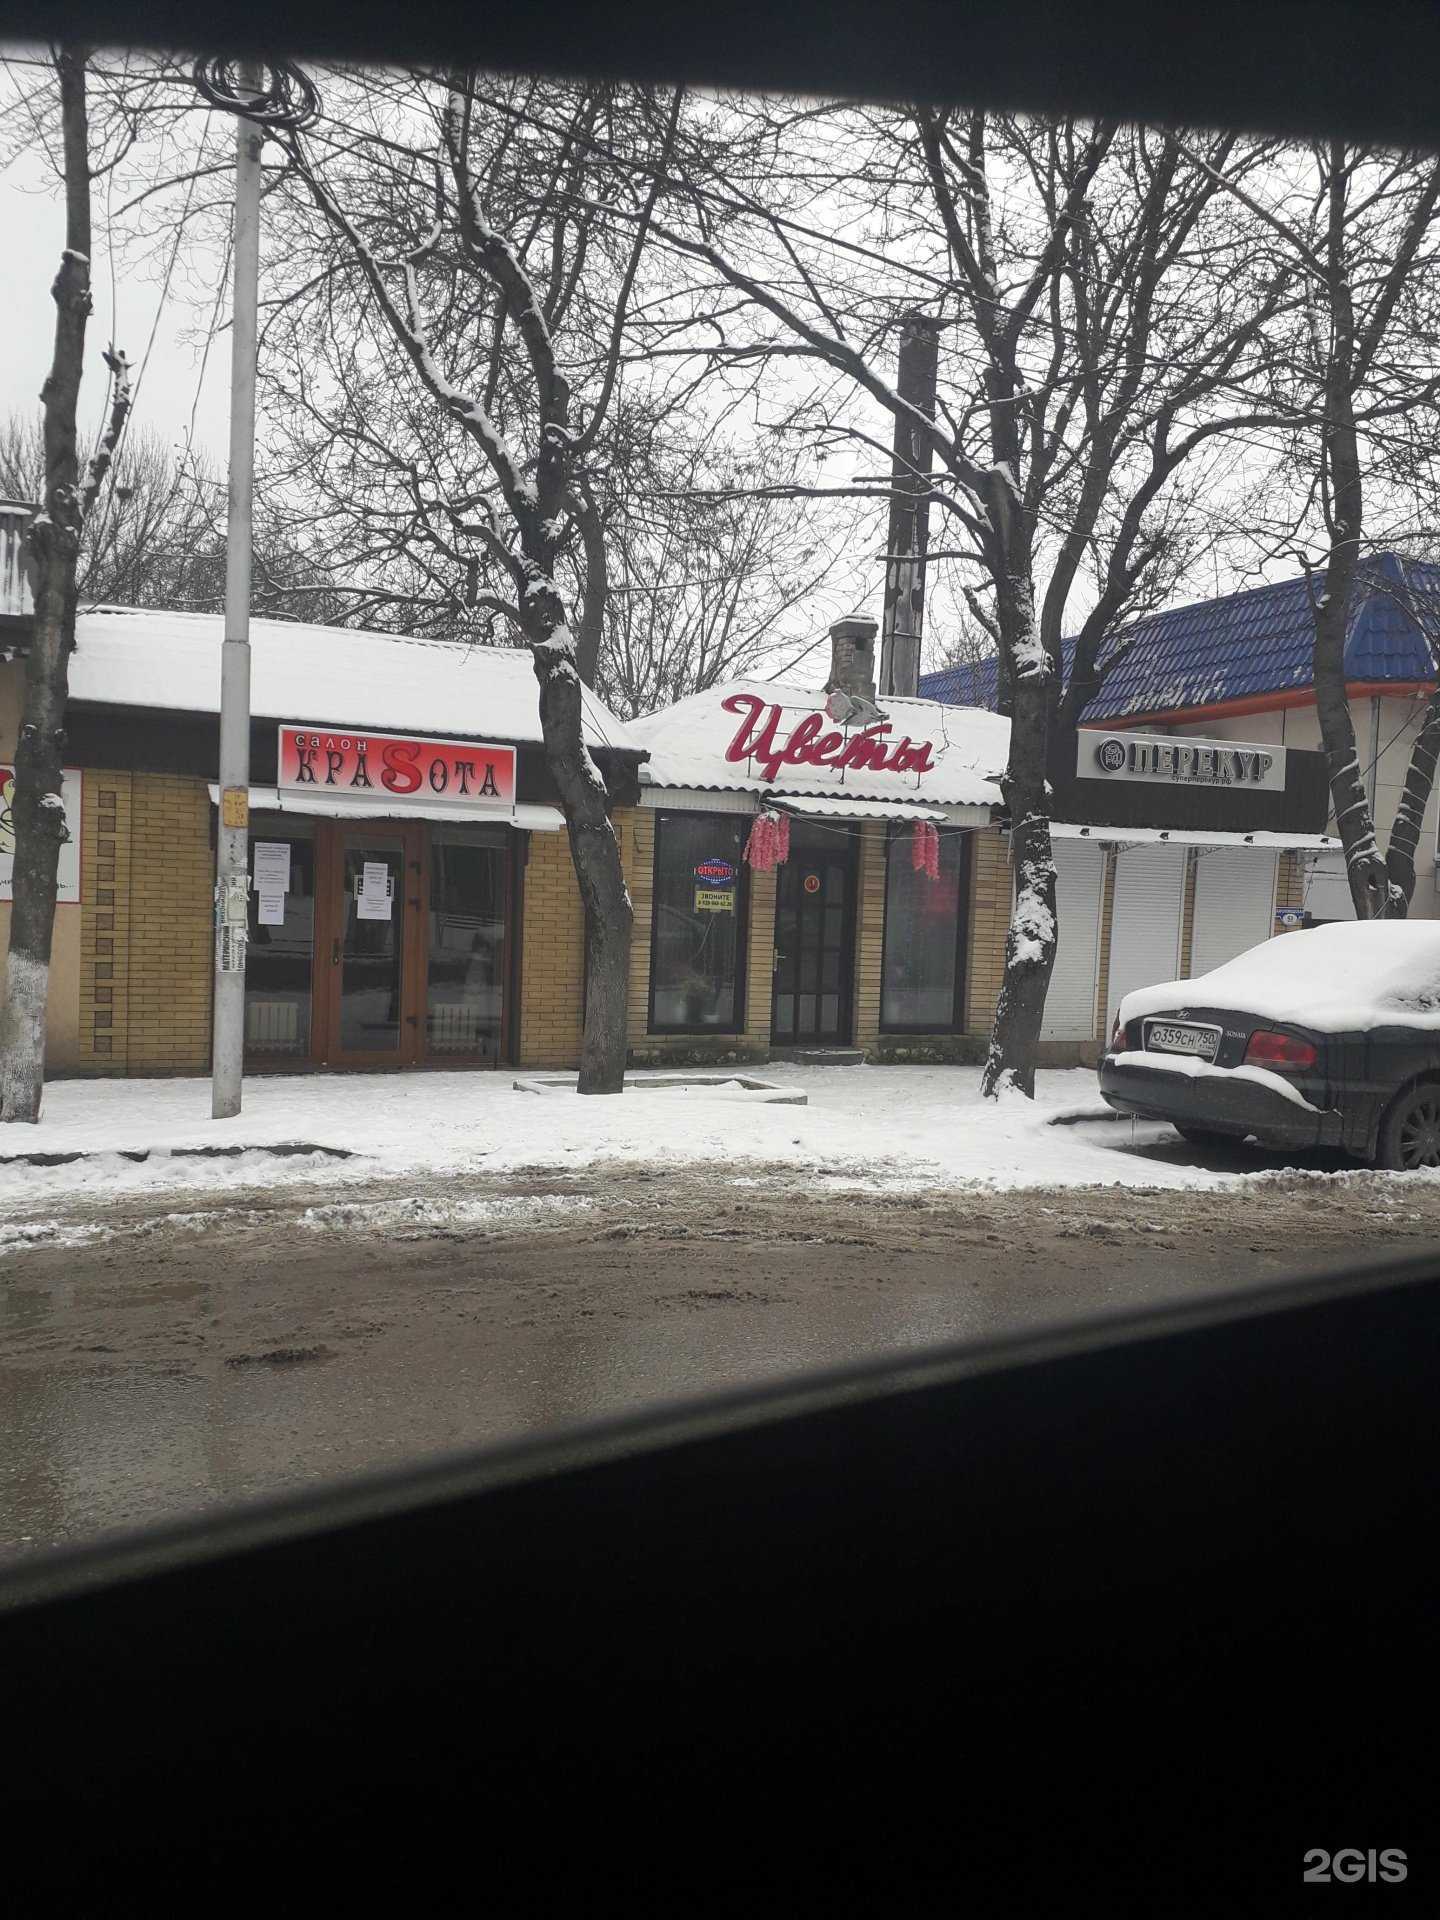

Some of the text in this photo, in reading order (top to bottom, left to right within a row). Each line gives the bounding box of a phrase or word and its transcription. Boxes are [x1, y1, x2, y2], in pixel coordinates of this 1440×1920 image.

[721, 693, 934, 784] Цветы
[1130, 741, 1273, 781] ПЕРЕКУР
[697, 865, 734, 877] ОТКРЫТО
